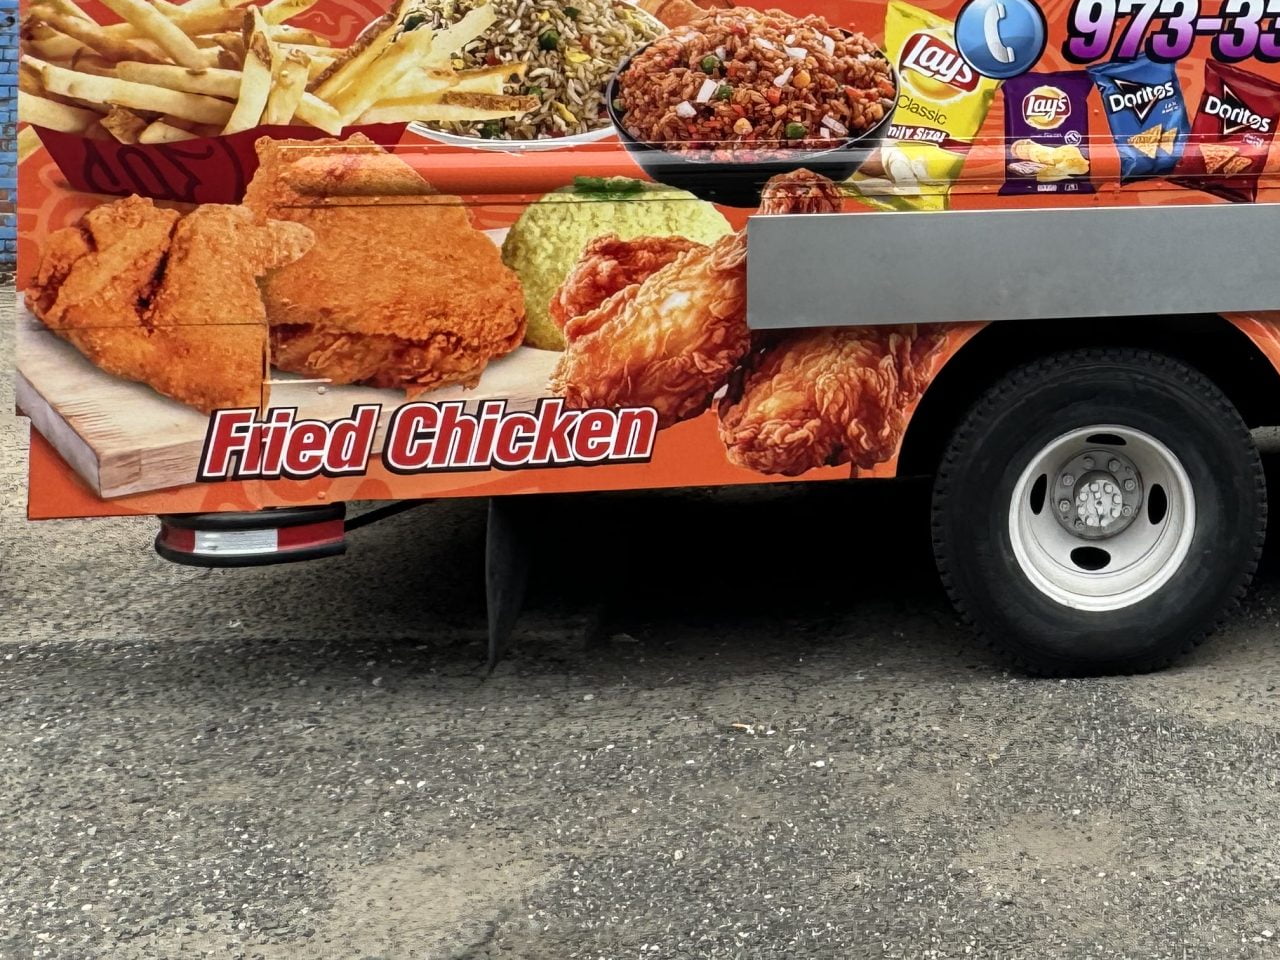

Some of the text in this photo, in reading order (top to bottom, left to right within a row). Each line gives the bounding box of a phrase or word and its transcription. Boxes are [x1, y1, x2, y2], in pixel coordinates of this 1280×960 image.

[896, 94, 947, 125] Classic
[1109, 82, 1174, 112] Doritos
[1205, 95, 1271, 132] Doritos
[197, 397, 660, 482] Fried Chicken
